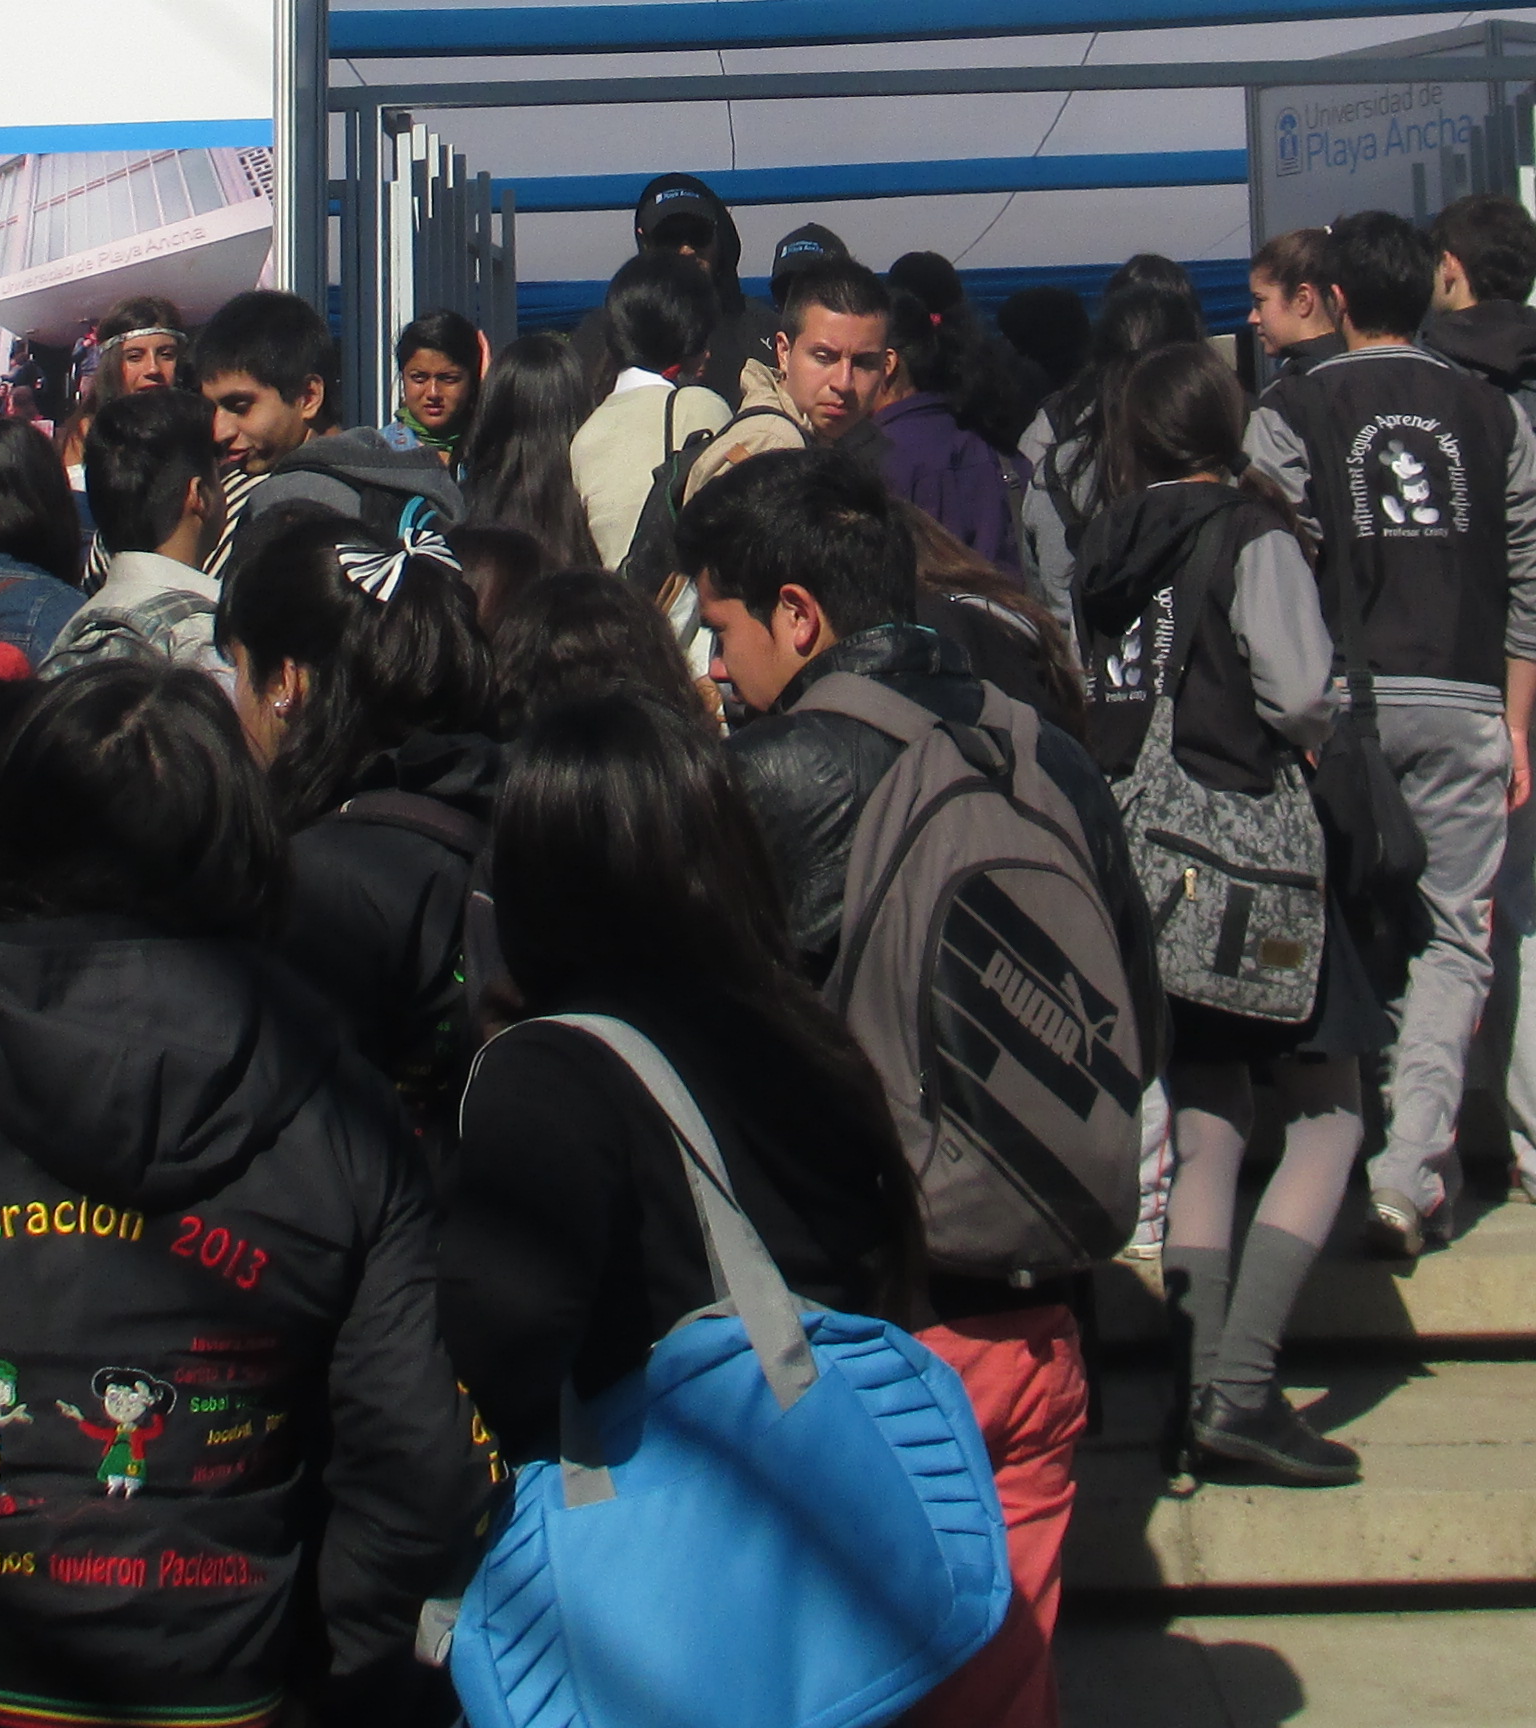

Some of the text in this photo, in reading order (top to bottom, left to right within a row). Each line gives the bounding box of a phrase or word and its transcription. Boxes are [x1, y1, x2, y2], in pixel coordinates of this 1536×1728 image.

[1305, 81, 1443, 129] Universidad de
[1306, 108, 1472, 174] Playa Ancha
[97, 245, 143, 269] Playa
[145, 226, 207, 252] Ancha
[169, 1215, 270, 1290] 2013
[49, 1549, 148, 1588] tuvieron
